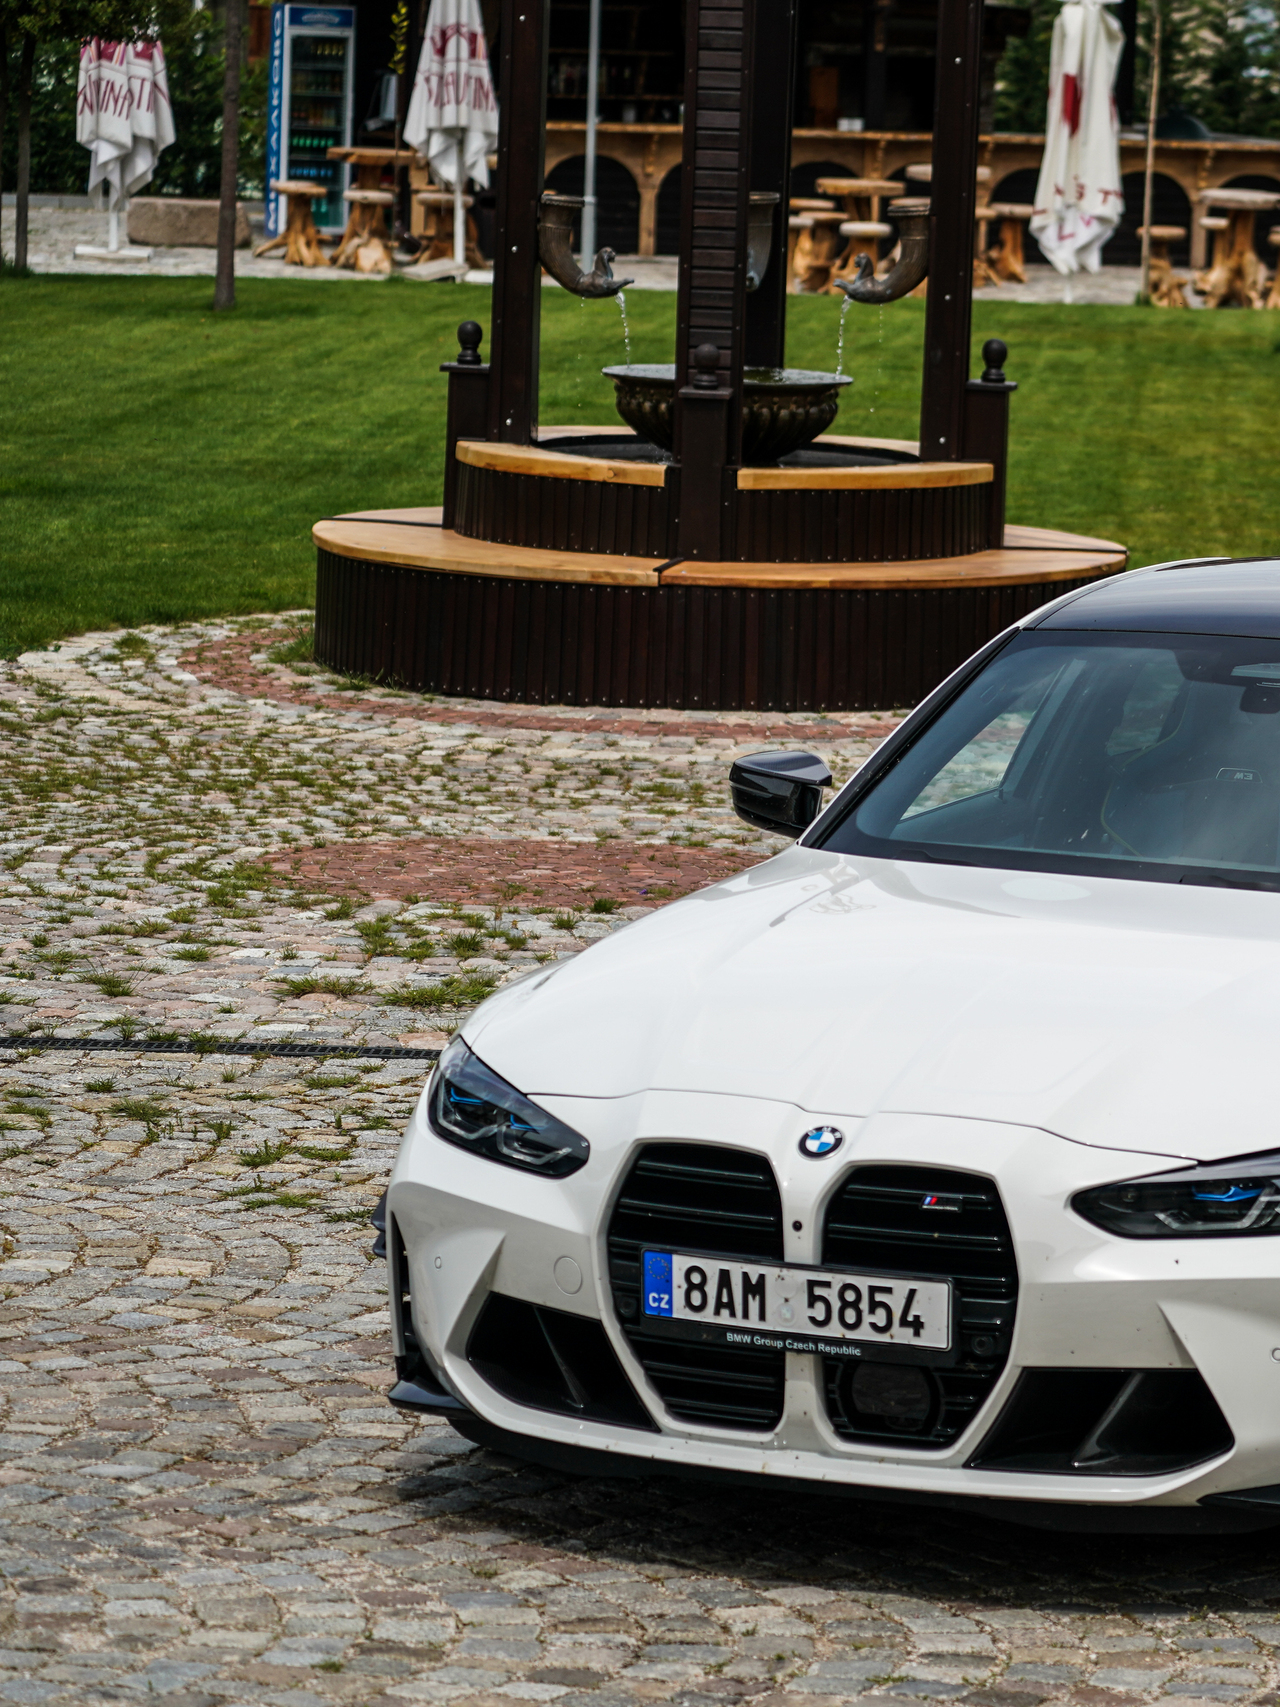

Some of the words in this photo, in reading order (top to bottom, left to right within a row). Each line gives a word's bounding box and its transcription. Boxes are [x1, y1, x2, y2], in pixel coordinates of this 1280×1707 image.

[1233, 772, 1253, 781] M3
[648, 1292, 669, 1309] CZ
[684, 1265, 766, 1322] 8AM
[806, 1279, 925, 1337] 5854
[726, 1332, 751, 1344] BMW
[753, 1336, 783, 1348] Group
[785, 1340, 815, 1351] Czech
[818, 1343, 861, 1356] Republic
